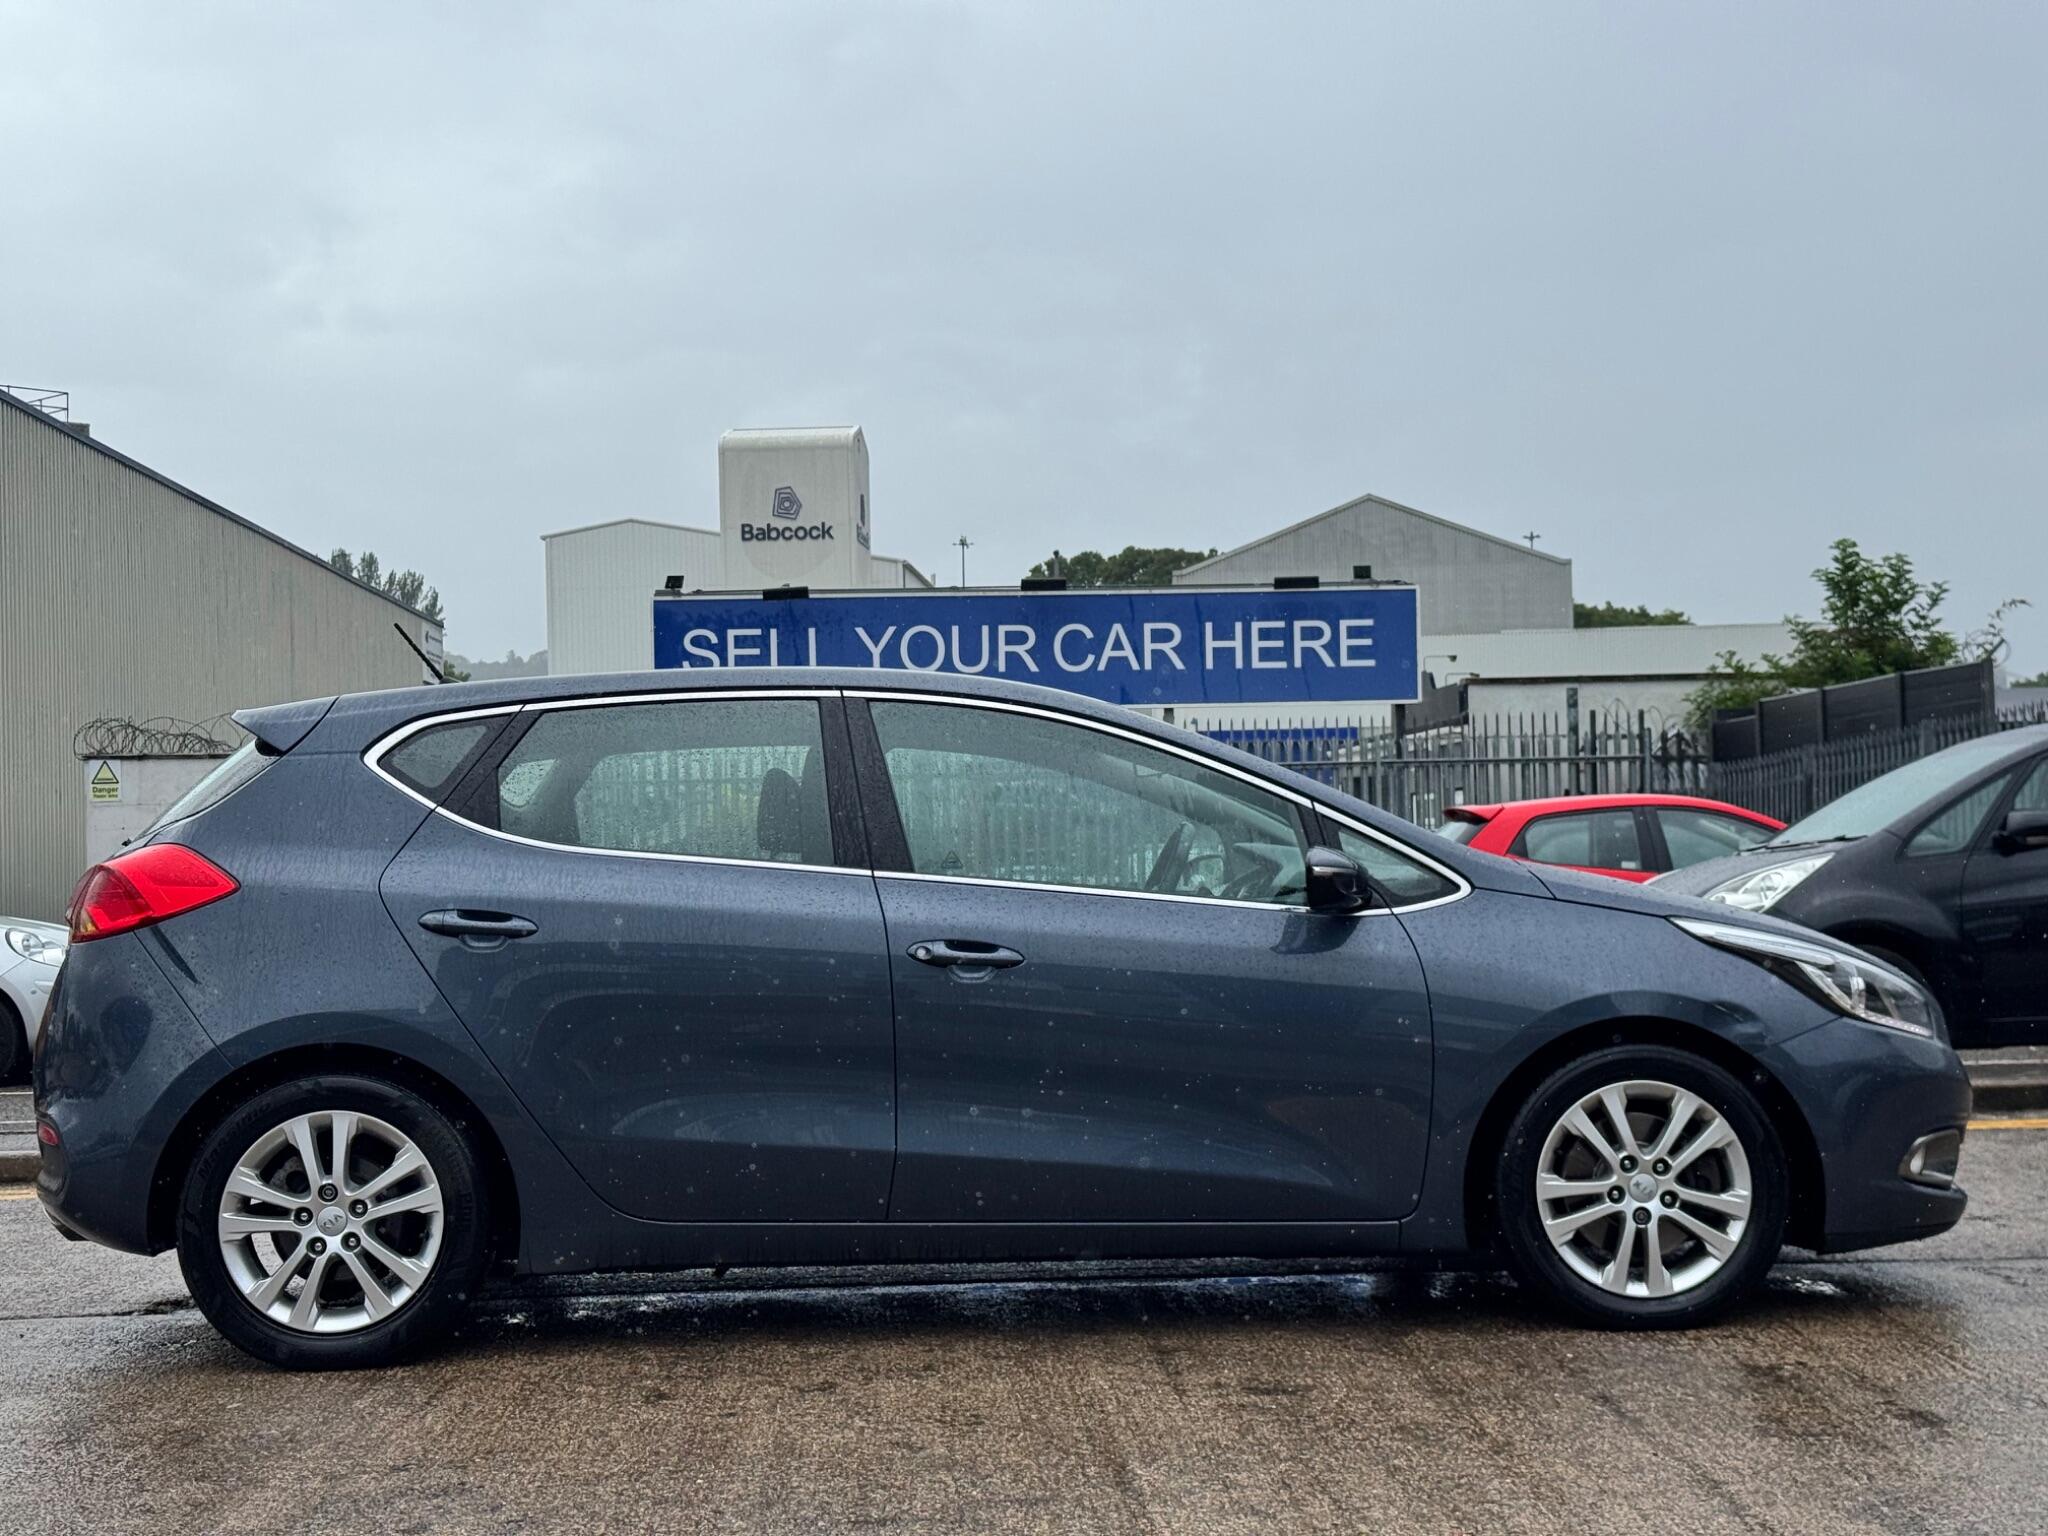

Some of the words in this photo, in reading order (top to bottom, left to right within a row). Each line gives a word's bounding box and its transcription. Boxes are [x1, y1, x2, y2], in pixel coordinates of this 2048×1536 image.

[741, 521, 834, 542] Babcock
[854, 624, 1040, 673] YOUR
[1053, 622, 1186, 673] CAR
[1205, 618, 1376, 670] HERE
[92, 786, 119, 794] Danger
